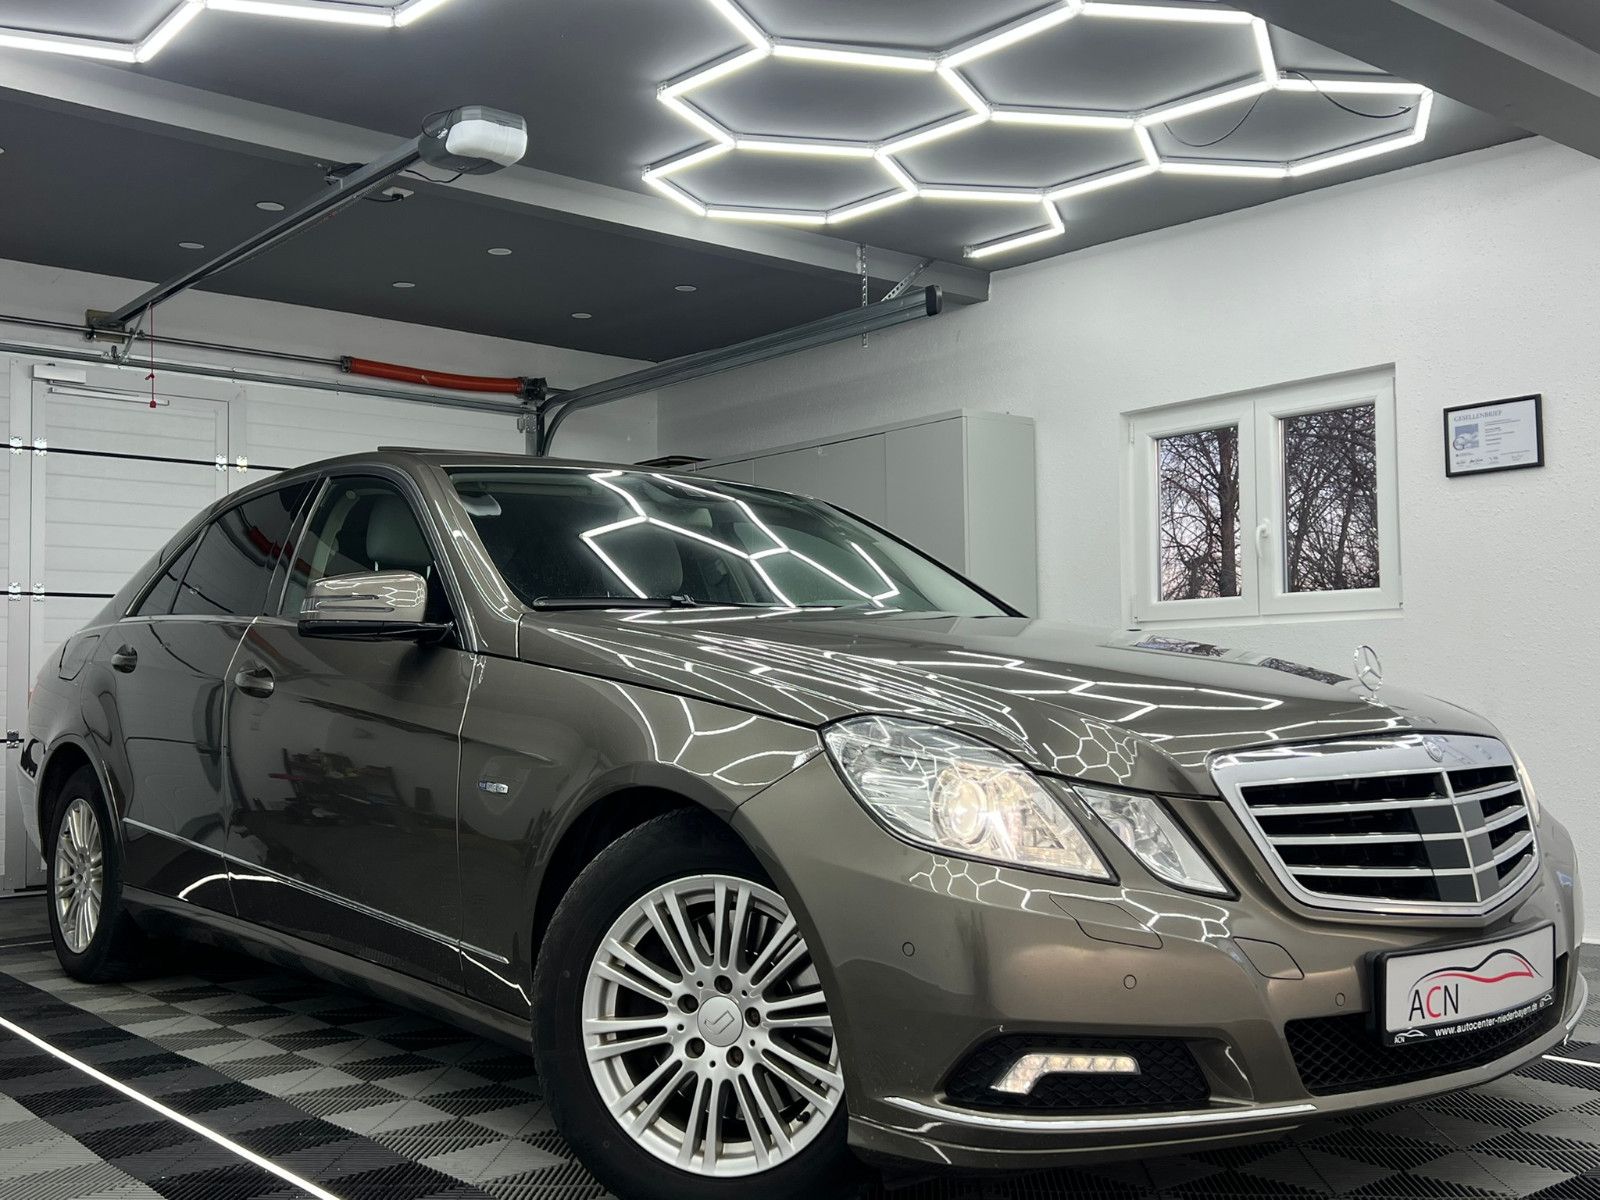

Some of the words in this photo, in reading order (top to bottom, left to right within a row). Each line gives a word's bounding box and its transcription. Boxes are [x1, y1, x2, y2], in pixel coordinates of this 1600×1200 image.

[1409, 984, 1459, 1021] ACN
[1434, 1003, 1538, 1037] www.autocenter-niederbayern.de
[1394, 1036, 1406, 1044] ACN
